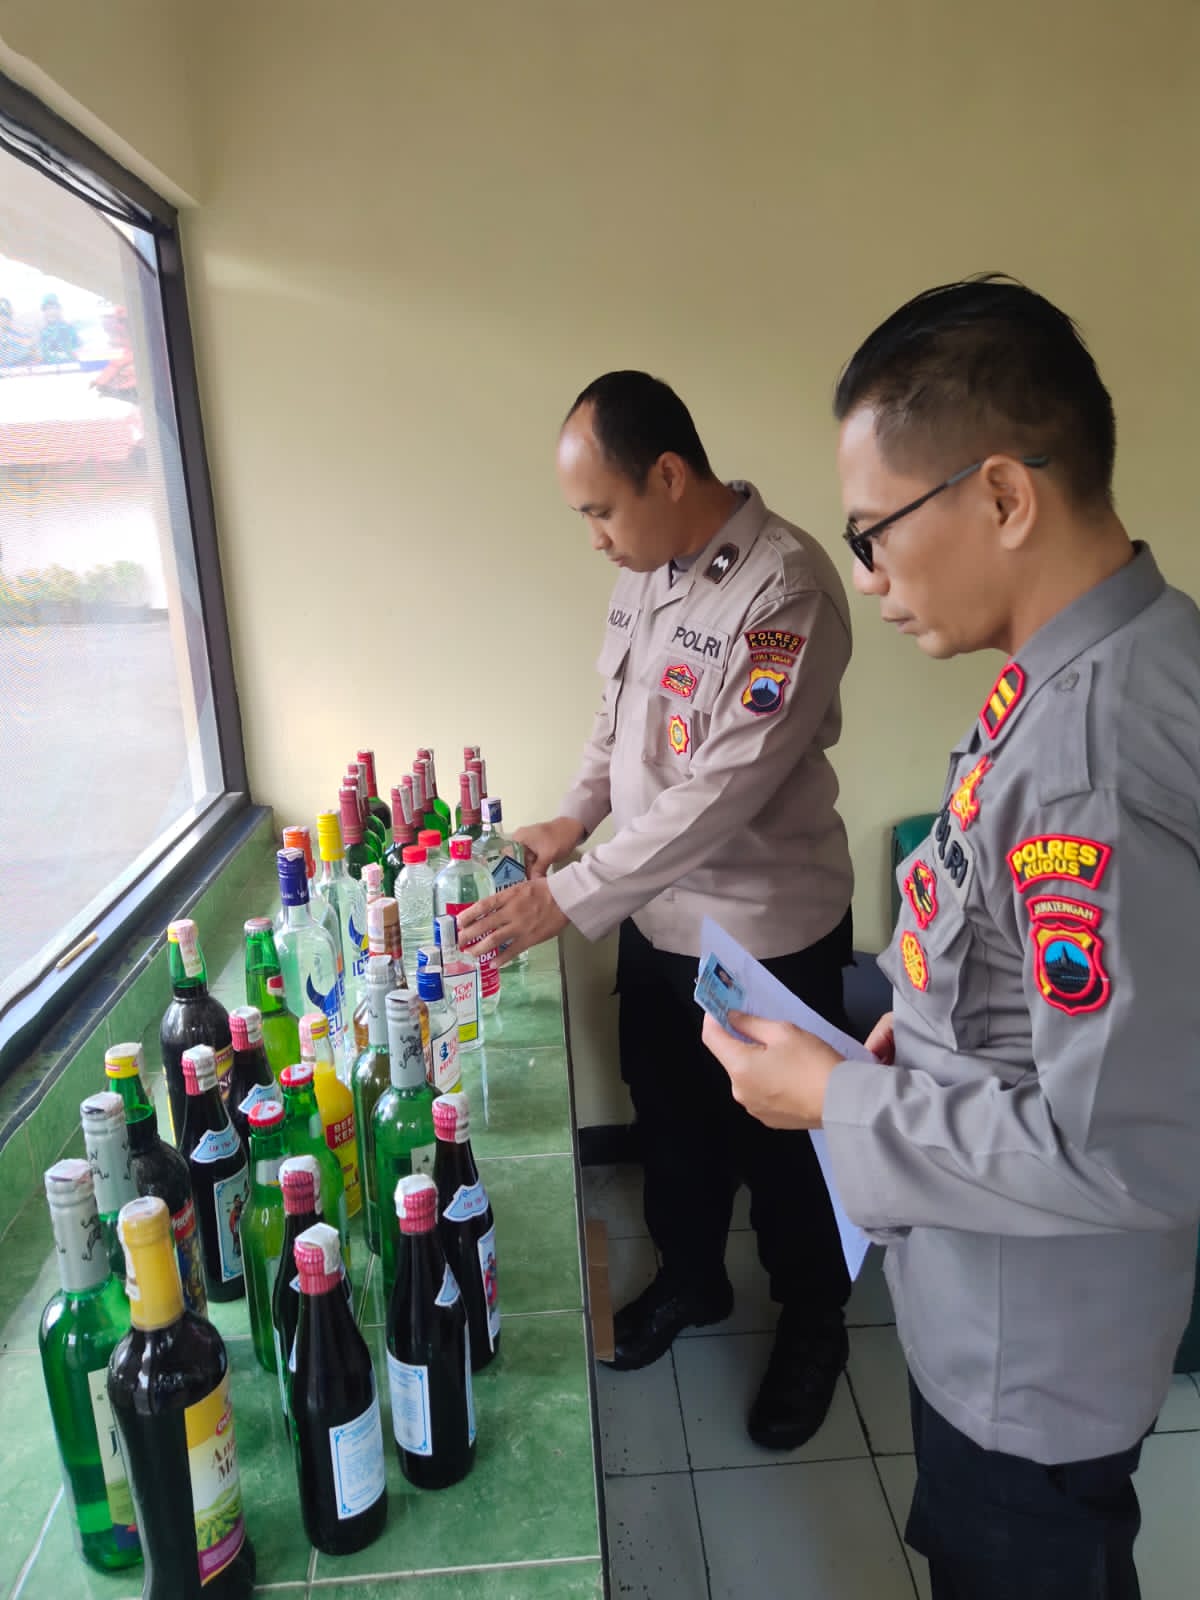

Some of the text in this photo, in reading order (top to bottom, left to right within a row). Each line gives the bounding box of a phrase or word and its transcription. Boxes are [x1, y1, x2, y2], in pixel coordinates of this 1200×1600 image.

[671, 625, 721, 659] POLRI
[749, 632, 799, 646] POLRES
[1012, 839, 1098, 873] POLRES
[1024, 858, 1080, 880] KUDUS
[479, 949, 498, 964] DKA
